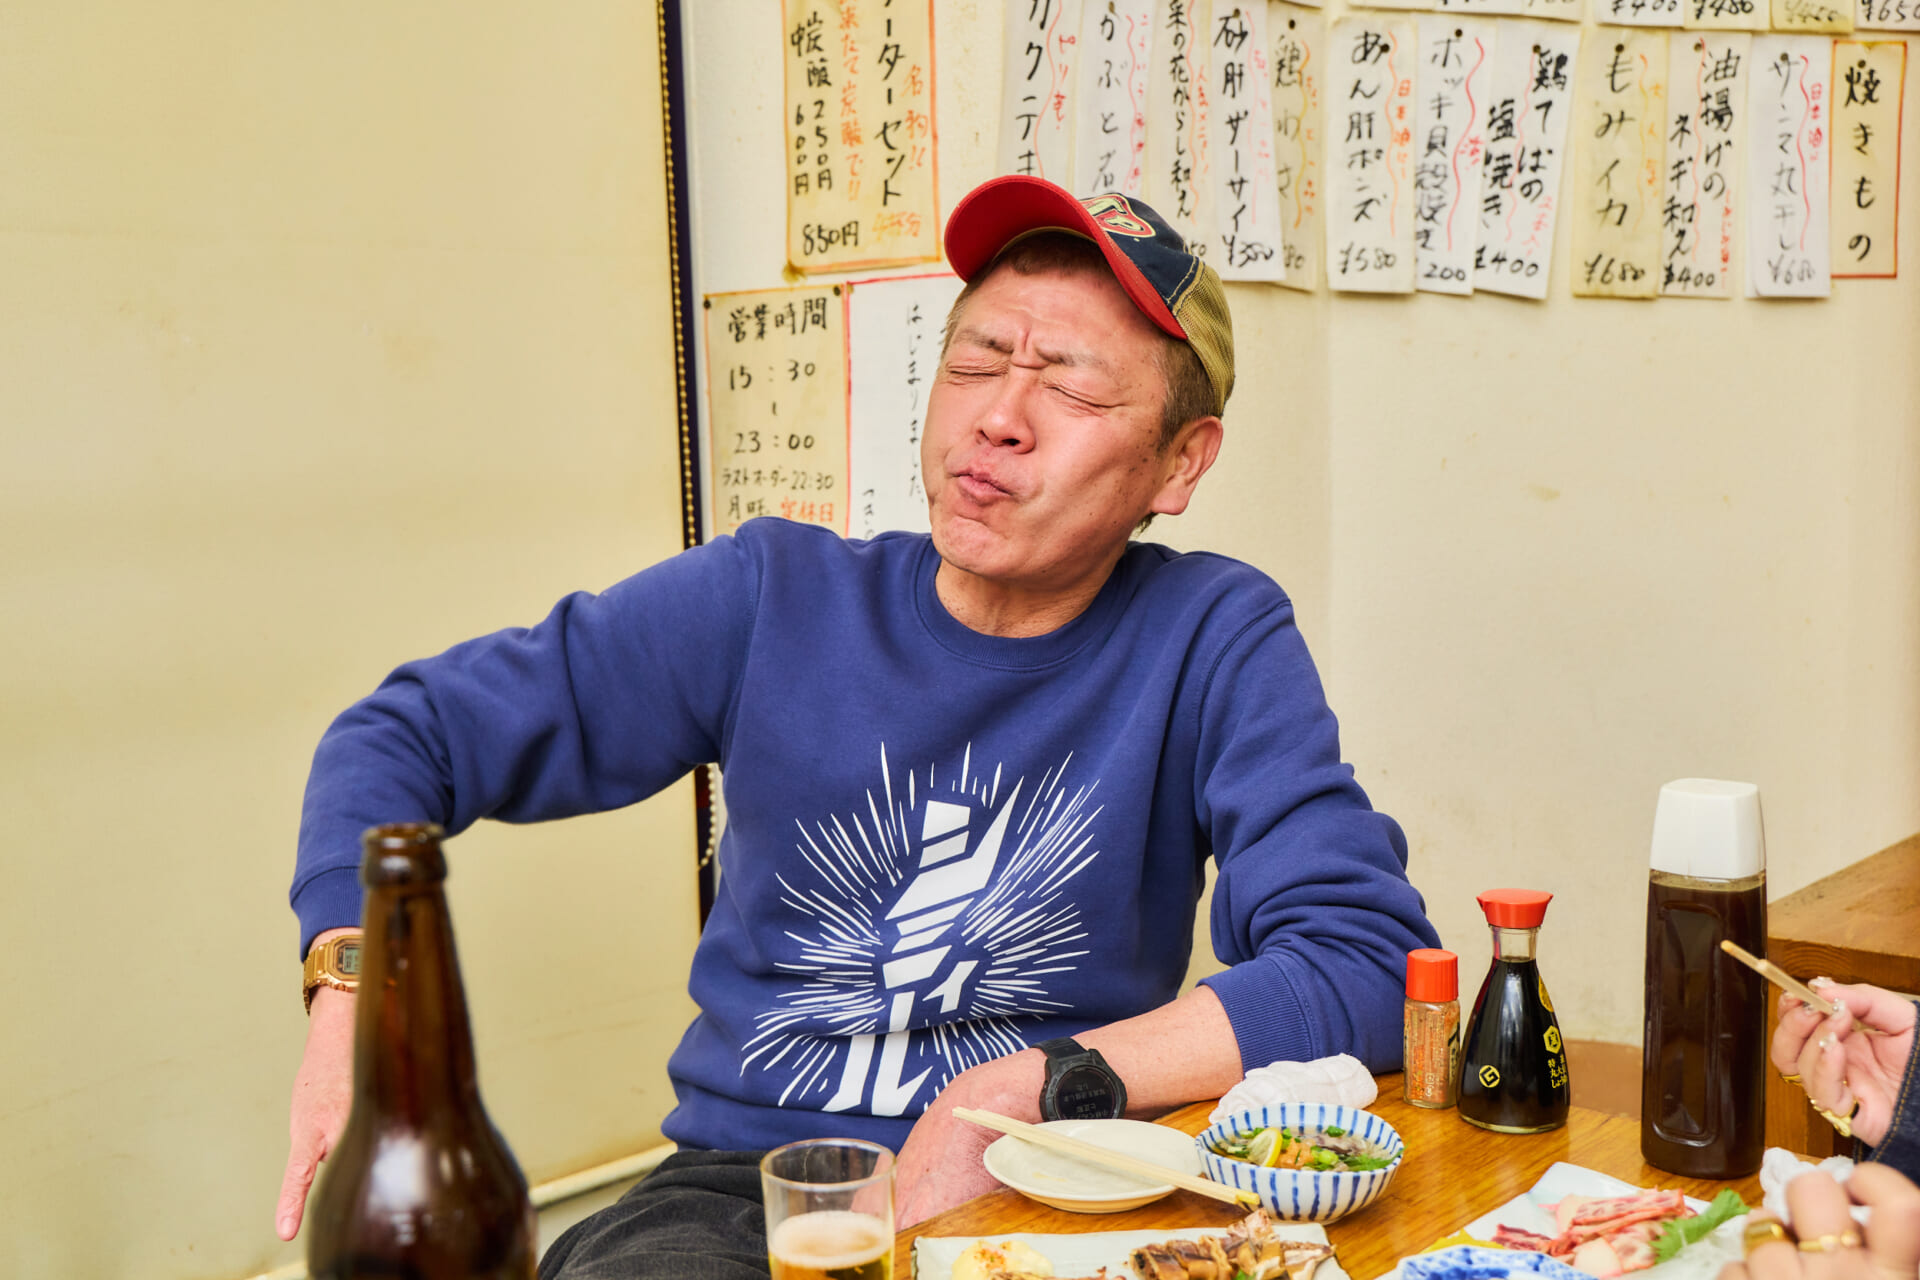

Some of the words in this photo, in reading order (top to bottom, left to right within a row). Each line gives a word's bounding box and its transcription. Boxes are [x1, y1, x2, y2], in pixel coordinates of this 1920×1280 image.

[875, 0, 907, 207] ーターセント
[1213, 14, 1249, 232] 砂肝ザーサイ
[1594, 50, 1636, 227] もみイカ
[1844, 65, 1882, 262] 焼きもの
[802, 220, 860, 257] 850円
[1339, 241, 1397, 275] ¥580
[1662, 264, 1716, 293] ¥400
[728, 296, 828, 343] 営業時間
[780, 496, 835, 523] 定休日
